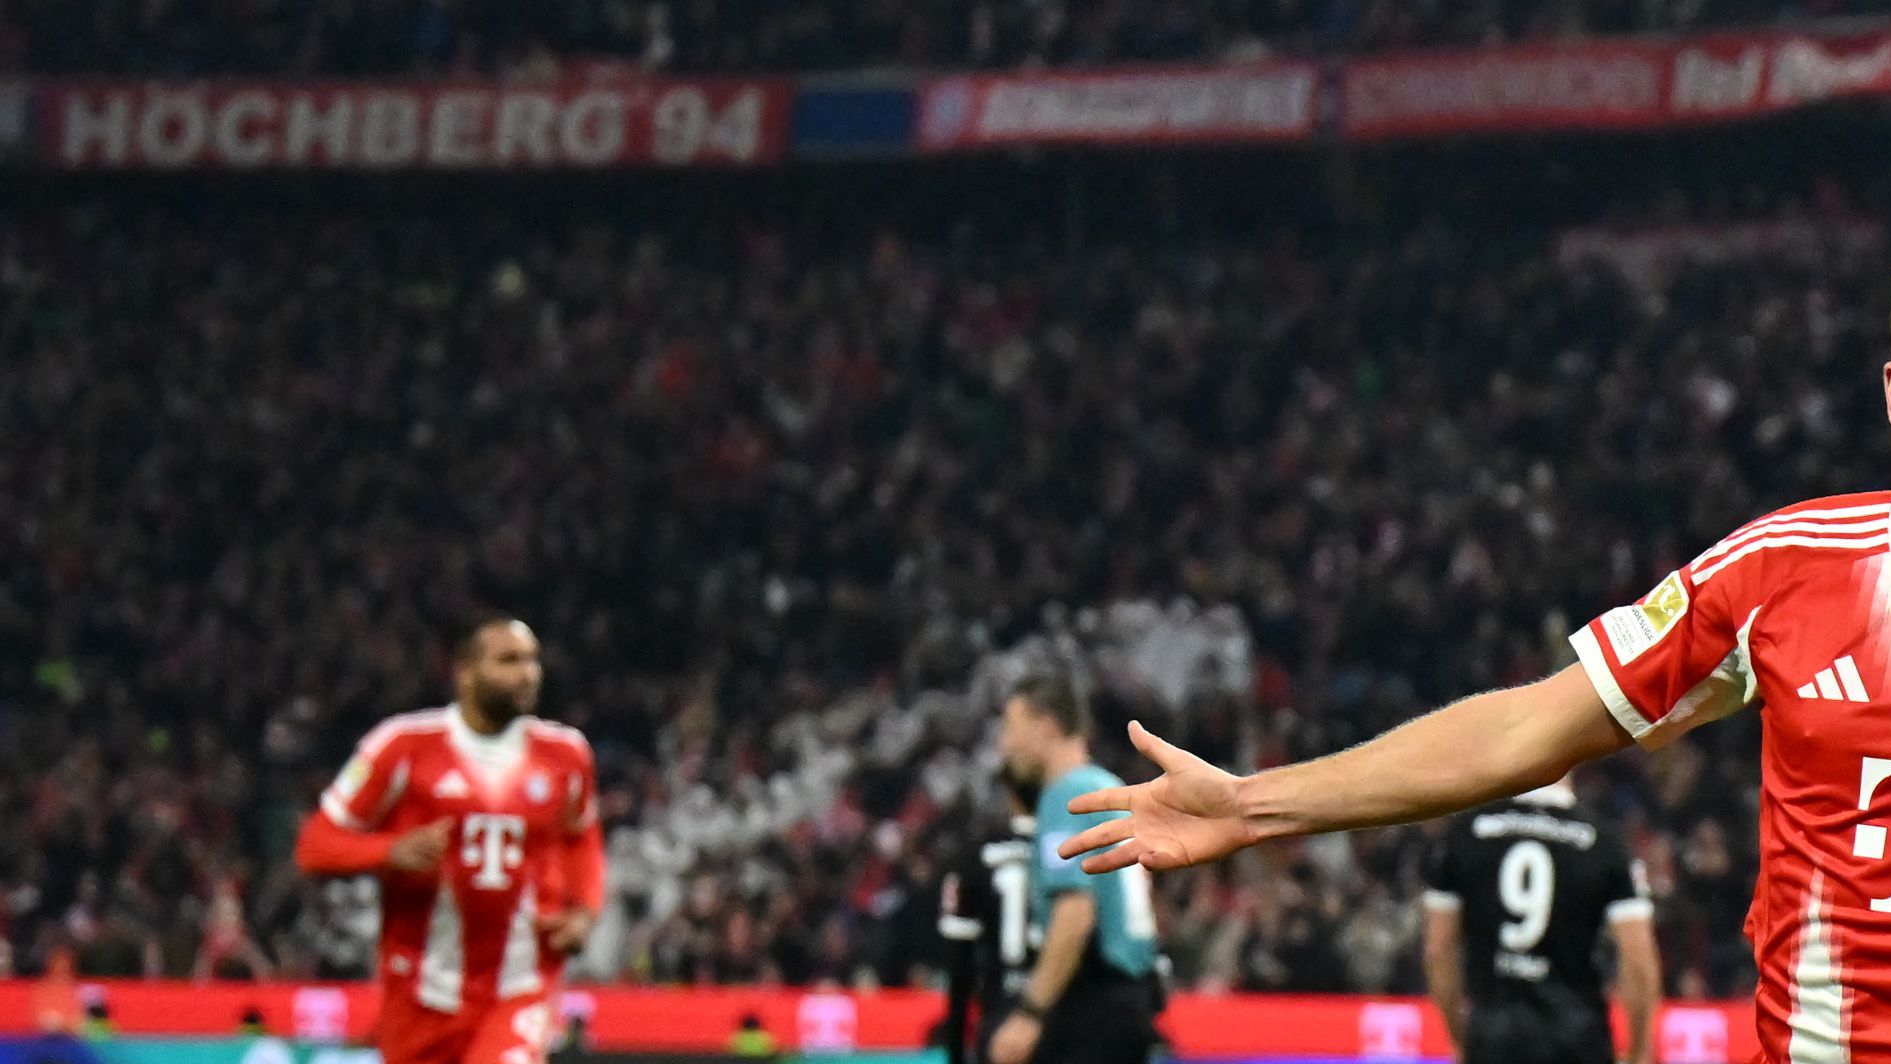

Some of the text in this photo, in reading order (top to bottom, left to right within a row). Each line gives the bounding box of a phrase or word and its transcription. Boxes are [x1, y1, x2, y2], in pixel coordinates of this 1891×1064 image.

[650, 86, 765, 166] 94
[460, 812, 526, 891] T
[1499, 839, 1556, 952] 9
